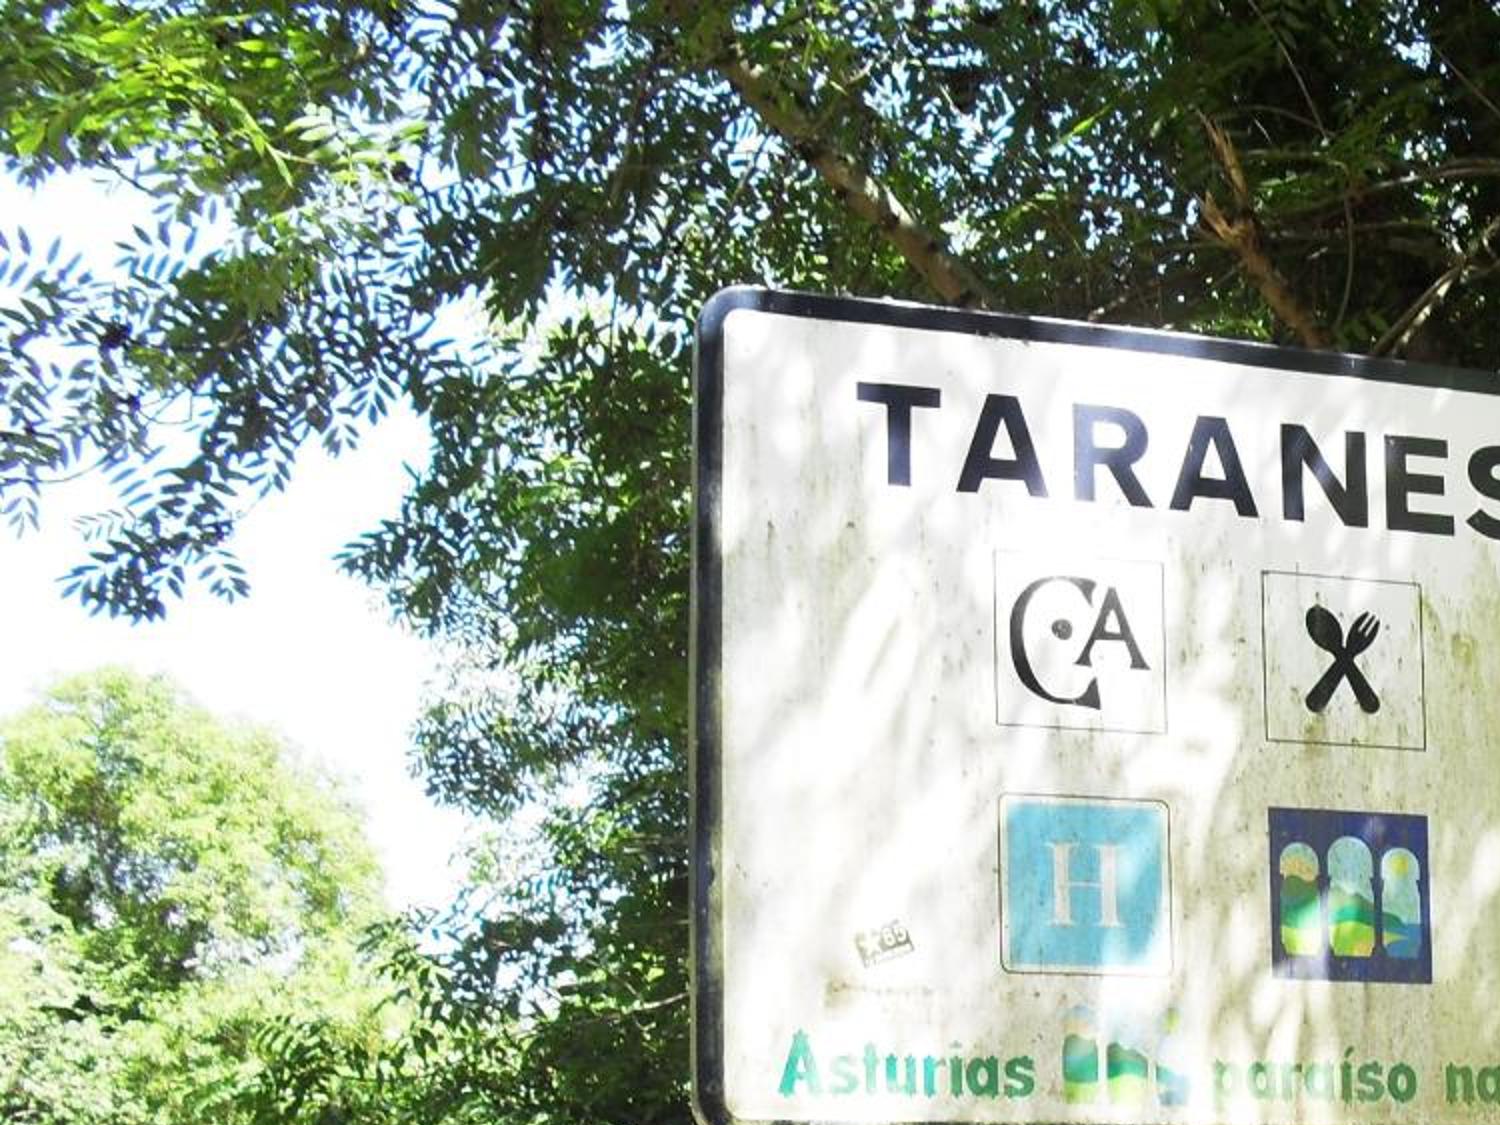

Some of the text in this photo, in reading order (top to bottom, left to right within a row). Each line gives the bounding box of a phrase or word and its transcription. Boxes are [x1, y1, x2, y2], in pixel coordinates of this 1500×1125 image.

[1044, 841, 1128, 929] H
[778, 1027, 1037, 1098] Asturias
[1213, 1047, 1419, 1106] paraíso
